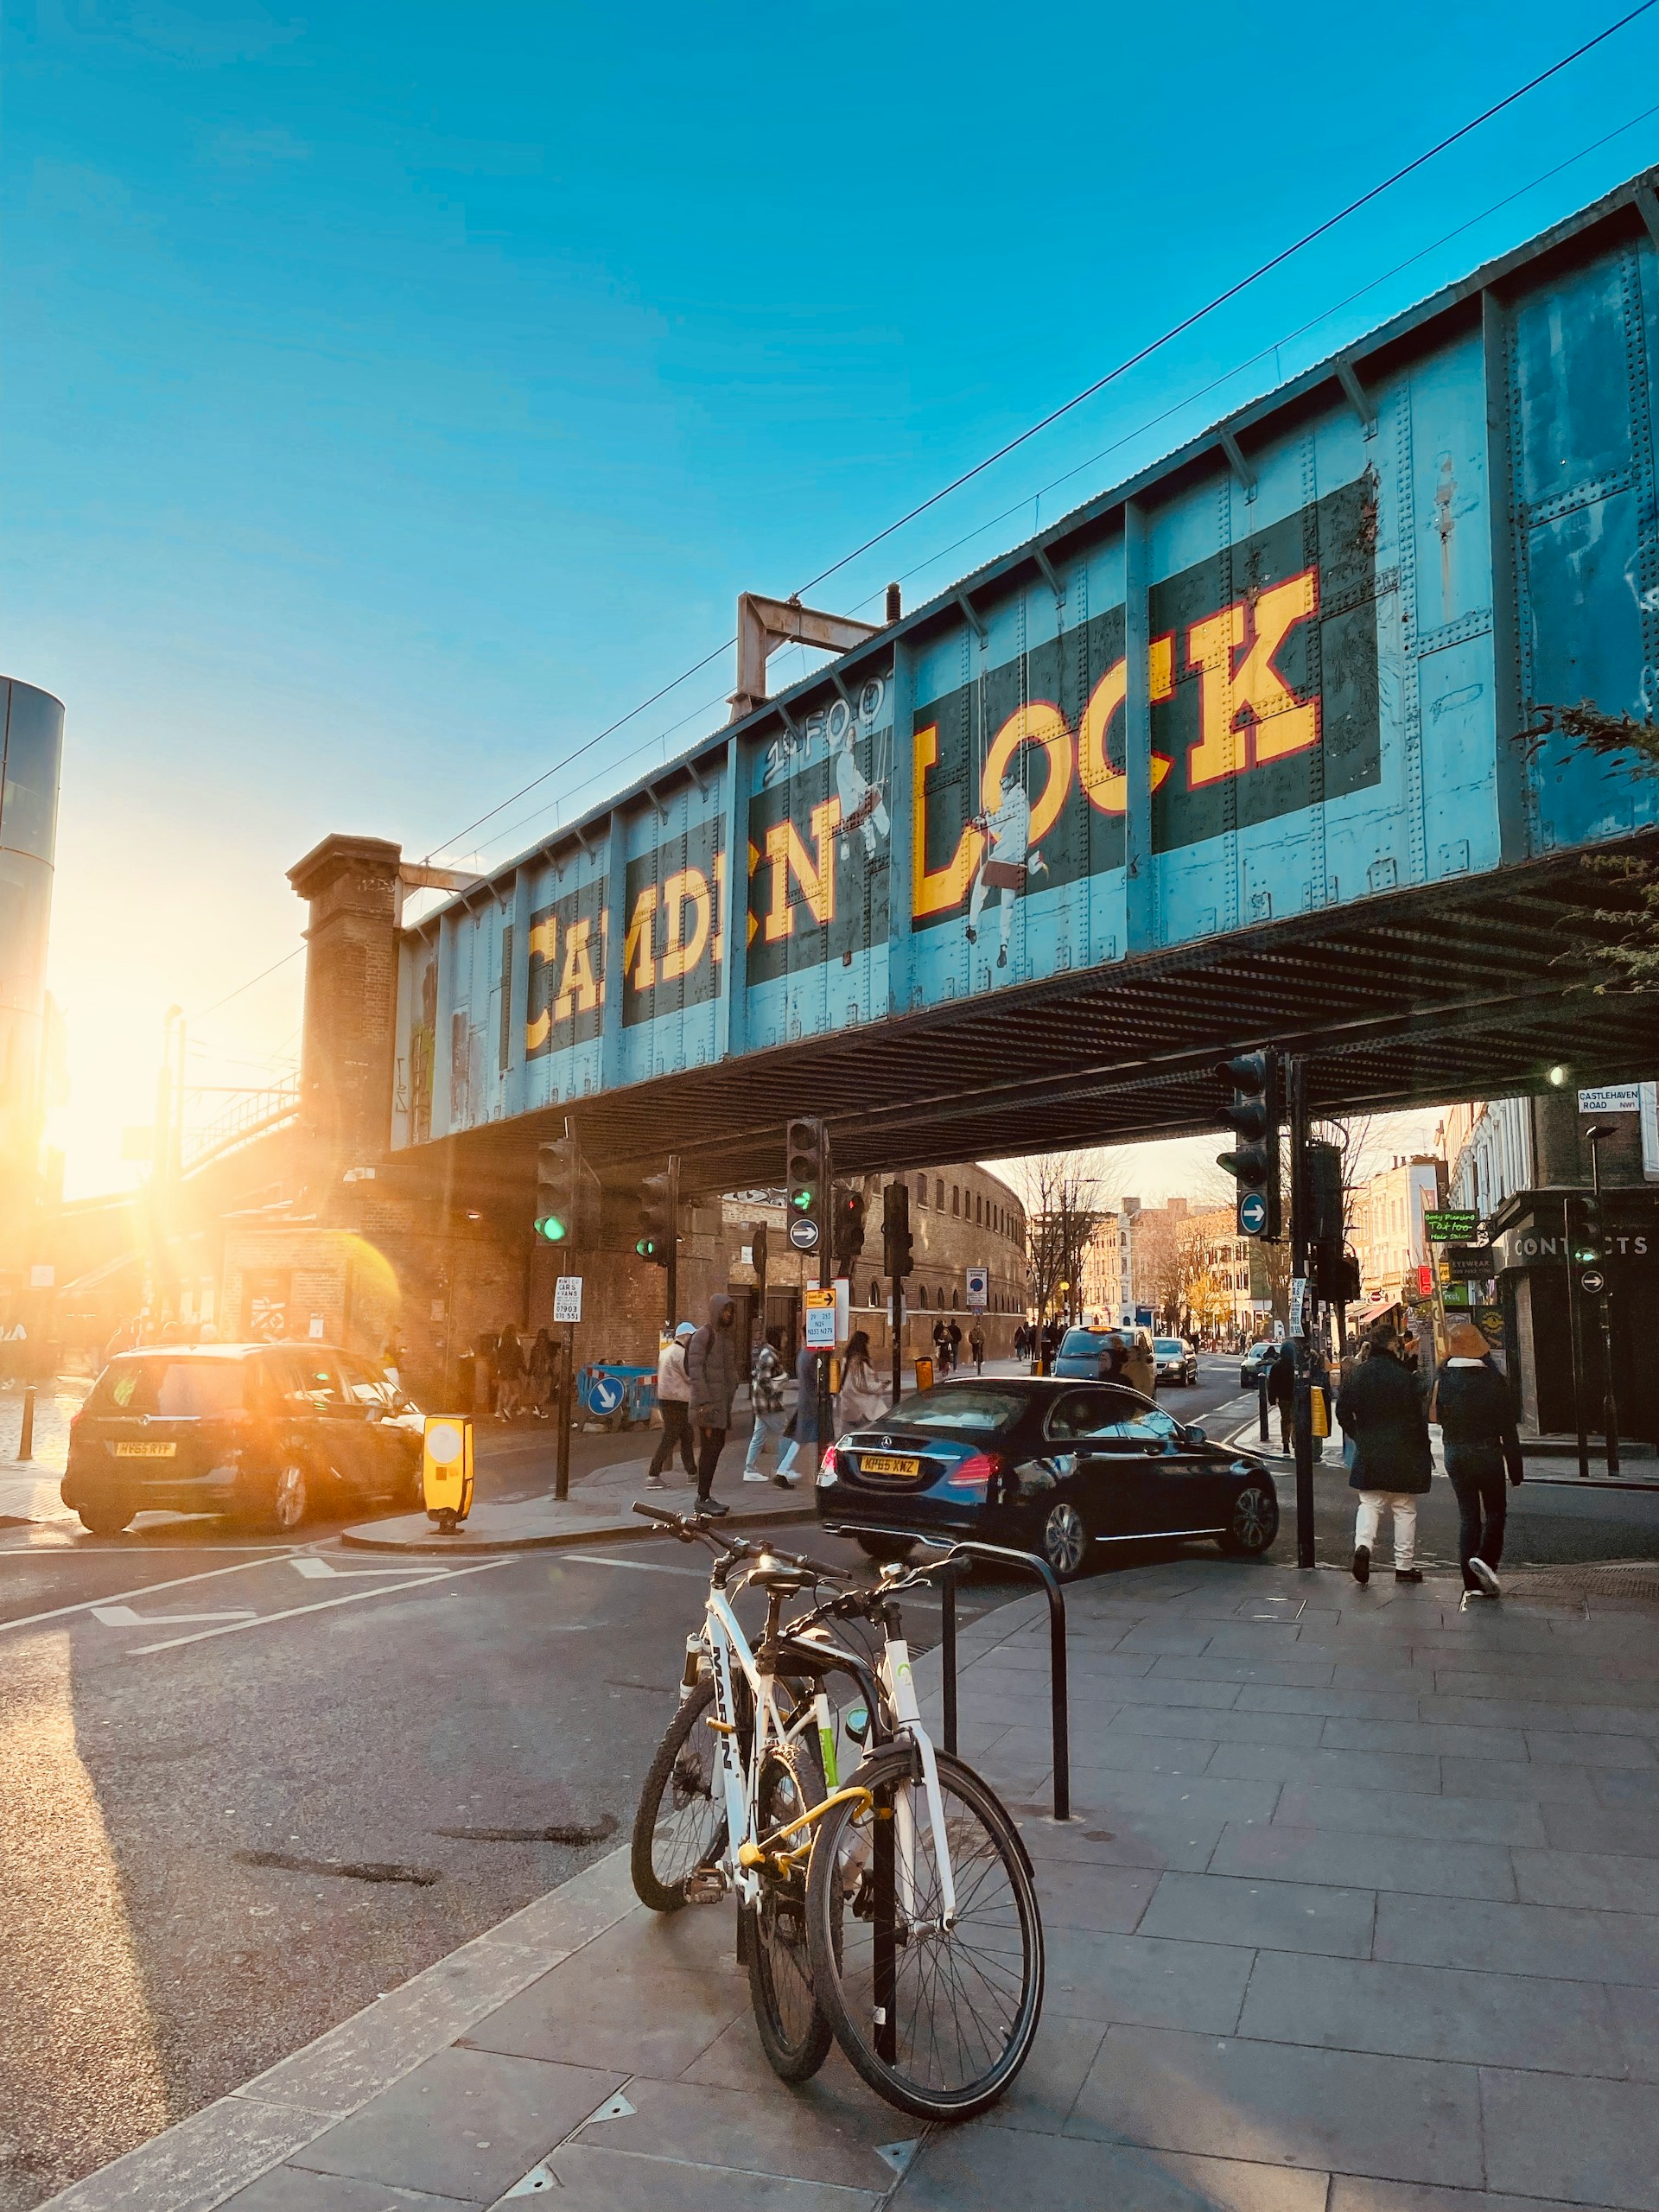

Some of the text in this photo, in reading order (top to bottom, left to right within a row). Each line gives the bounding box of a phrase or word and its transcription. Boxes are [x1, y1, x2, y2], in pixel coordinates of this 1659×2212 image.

[763, 667, 894, 788] 10FOO
[912, 564, 1322, 921] LOCK
[1580, 1090, 1638, 1100] CASTLEHAVEN
[1515, 1236, 1648, 1256] CONTCTS
[713, 1646, 733, 1770] MARIN
